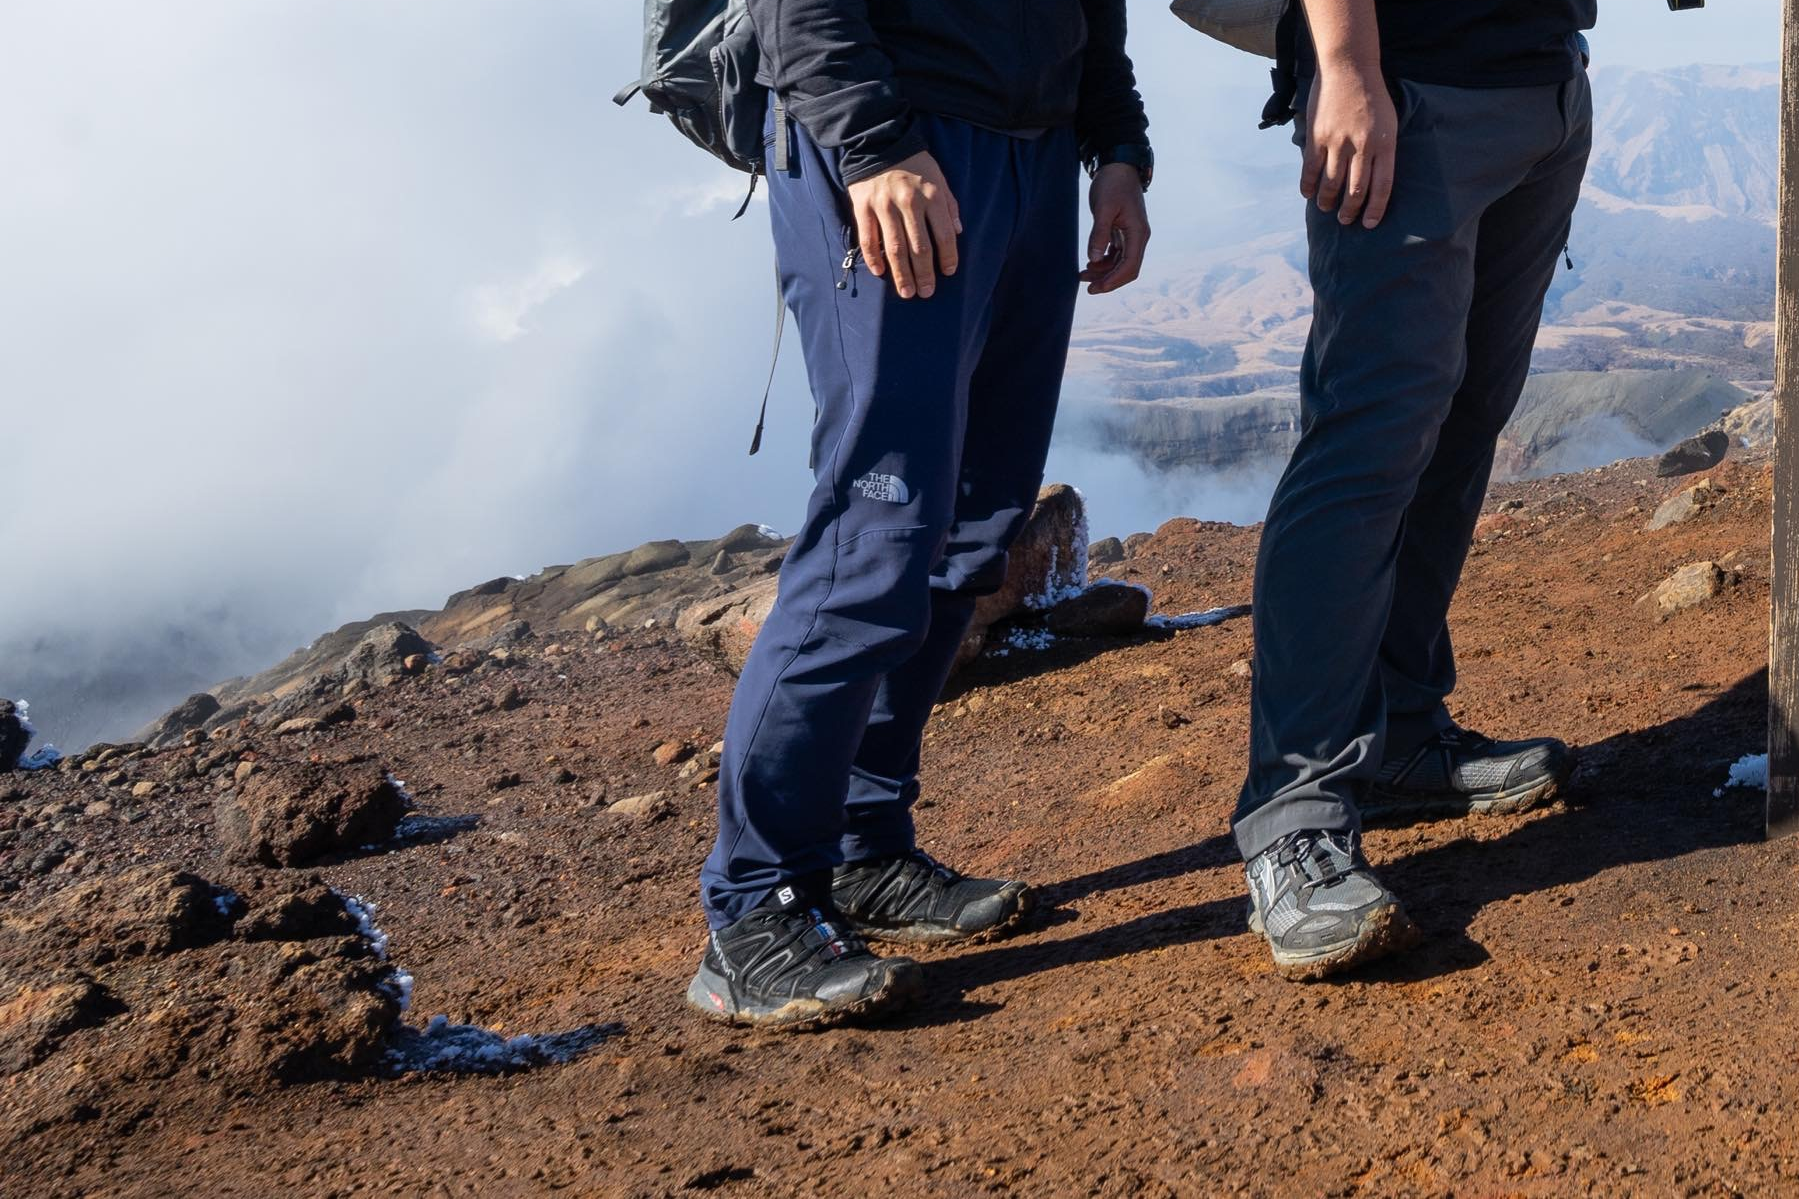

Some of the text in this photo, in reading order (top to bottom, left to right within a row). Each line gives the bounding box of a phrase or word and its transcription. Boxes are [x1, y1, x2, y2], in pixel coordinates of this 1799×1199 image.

[869, 472, 890, 483] THE
[853, 479, 889, 492] NORTH
[862, 489, 888, 501] FACE
